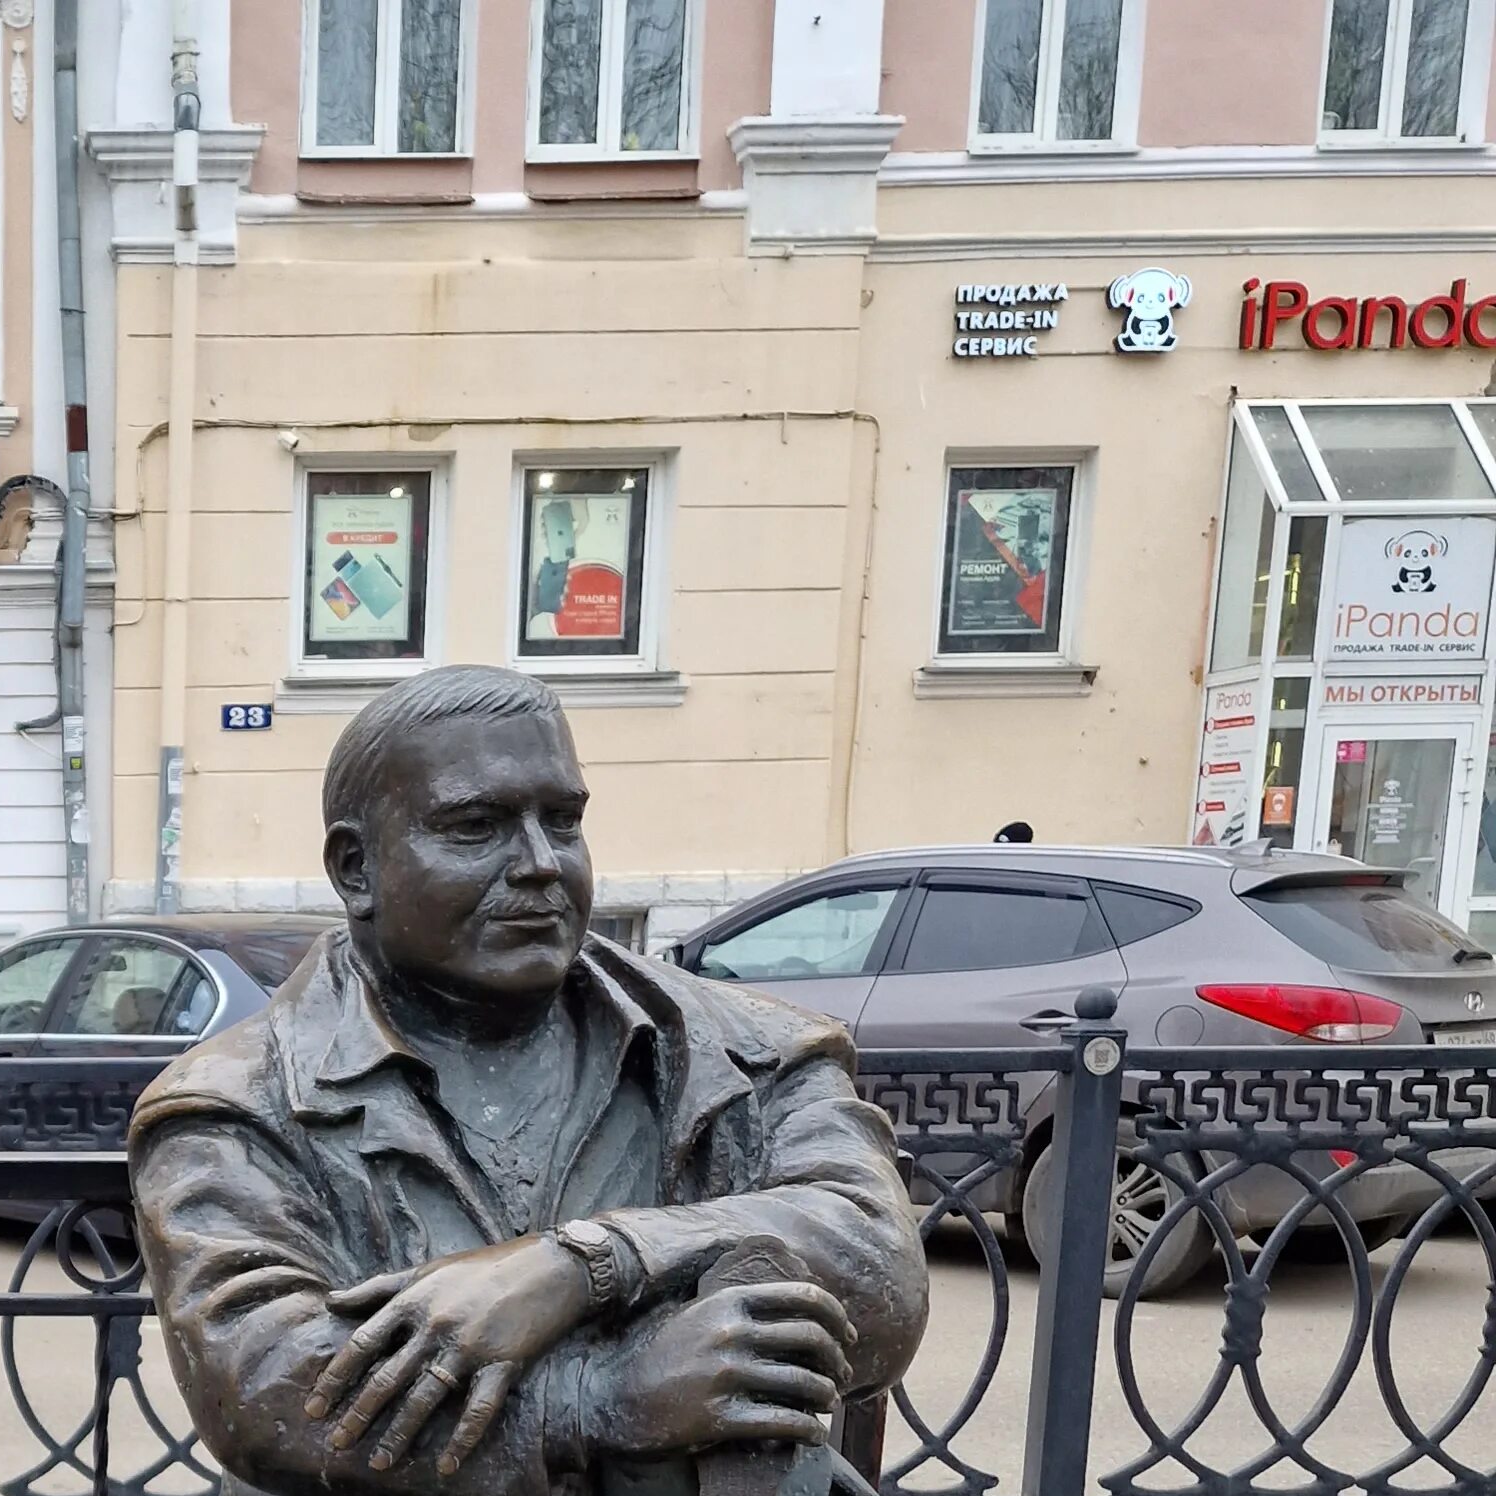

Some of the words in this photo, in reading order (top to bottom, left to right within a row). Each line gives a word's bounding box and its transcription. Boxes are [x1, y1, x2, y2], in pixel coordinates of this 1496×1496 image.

[956, 283, 1069, 304] ПРОДАЖА
[955, 309, 1059, 331] TRADE-IN
[953, 335, 1038, 358] СЕРВИС
[960, 564, 1008, 575] РЕМОНТ
[574, 594, 605, 604] TRADE
[1335, 602, 1480, 638] iPanda
[1333, 644, 1384, 654] ПРОДАЖА
[1389, 643, 1435, 652] TRADE-IN
[1439, 643, 1477, 652] СЕРВИС
[1325, 686, 1365, 703] МЫ
[1370, 684, 1479, 702] ОТКРЫТЫ
[228, 706, 264, 727] 23
